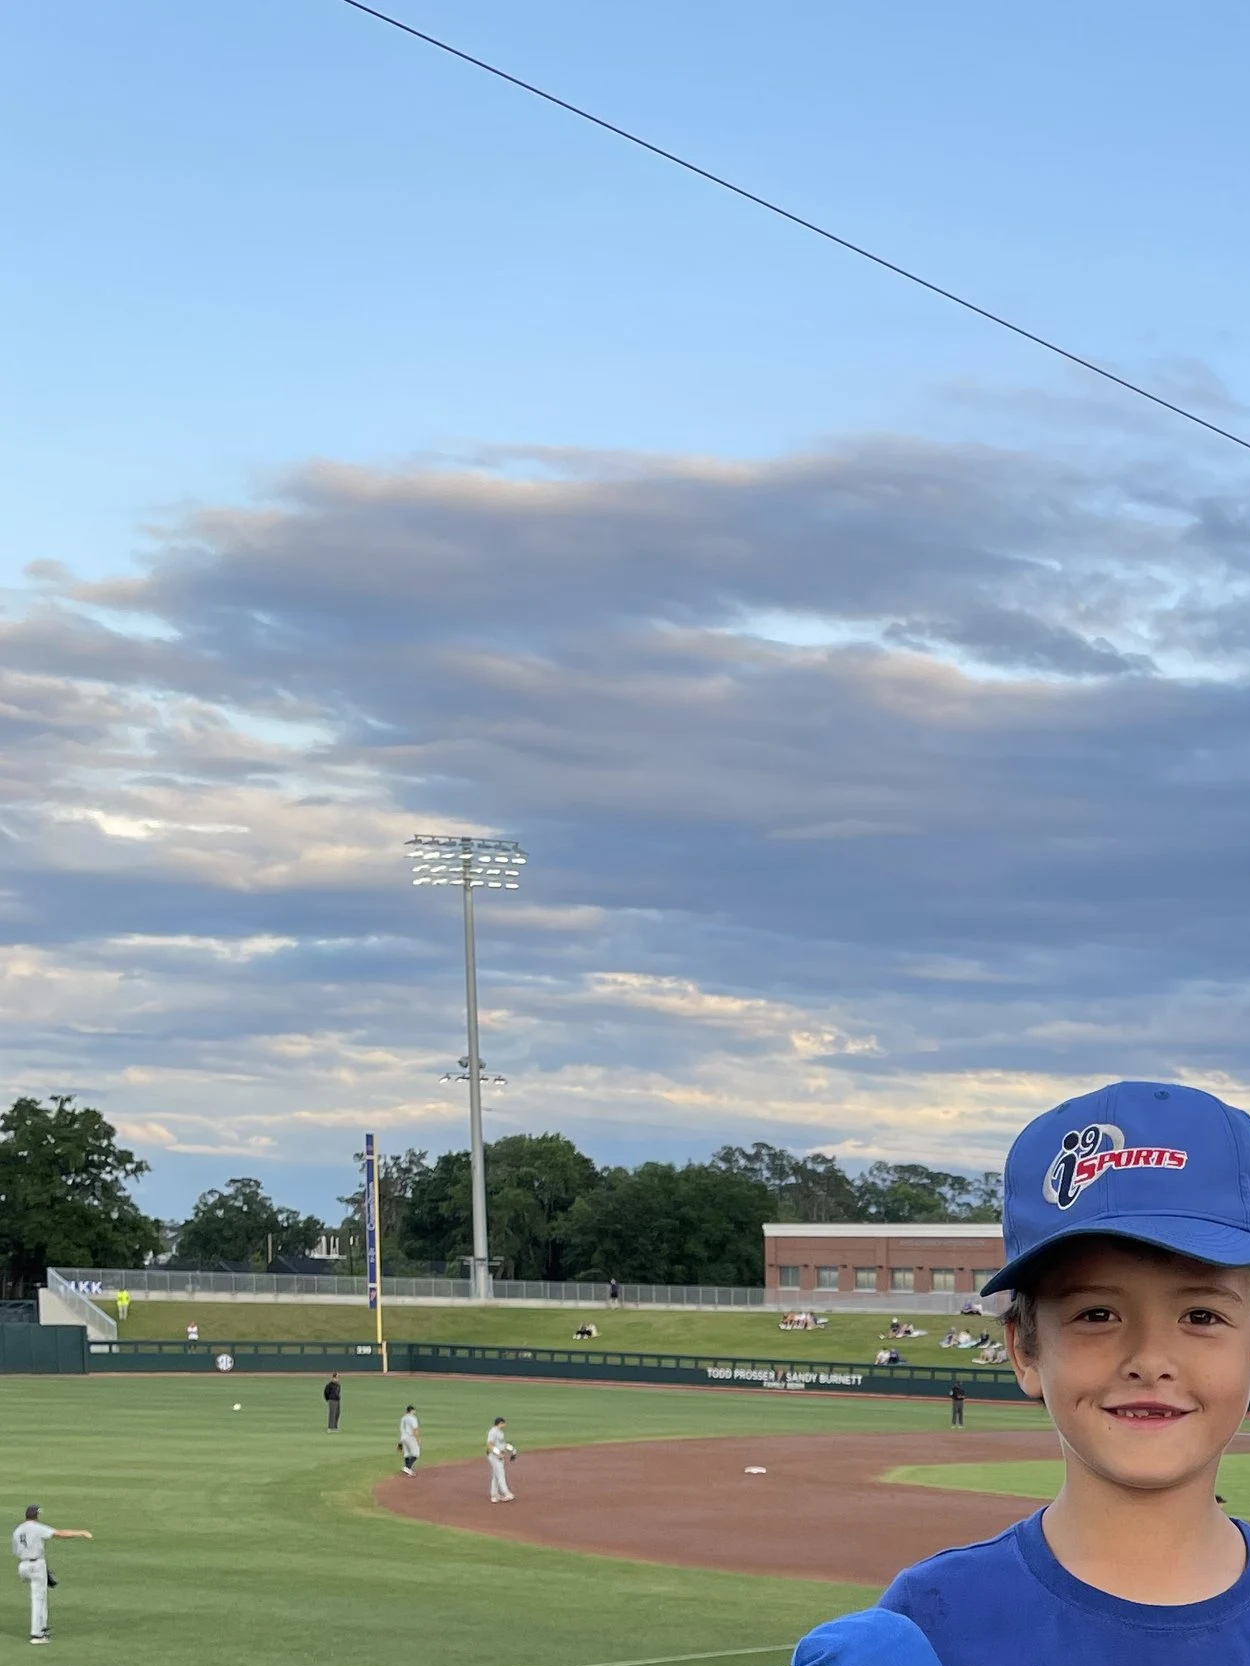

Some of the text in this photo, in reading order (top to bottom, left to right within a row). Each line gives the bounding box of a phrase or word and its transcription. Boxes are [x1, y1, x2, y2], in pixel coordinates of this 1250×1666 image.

[1074, 1147, 1188, 1185] SPORTS
[706, 1367, 732, 1379] TODD
[733, 1368, 776, 1382] PROSSER
[786, 1371, 818, 1383] SANDY
[819, 1373, 863, 1386] BURNETT
